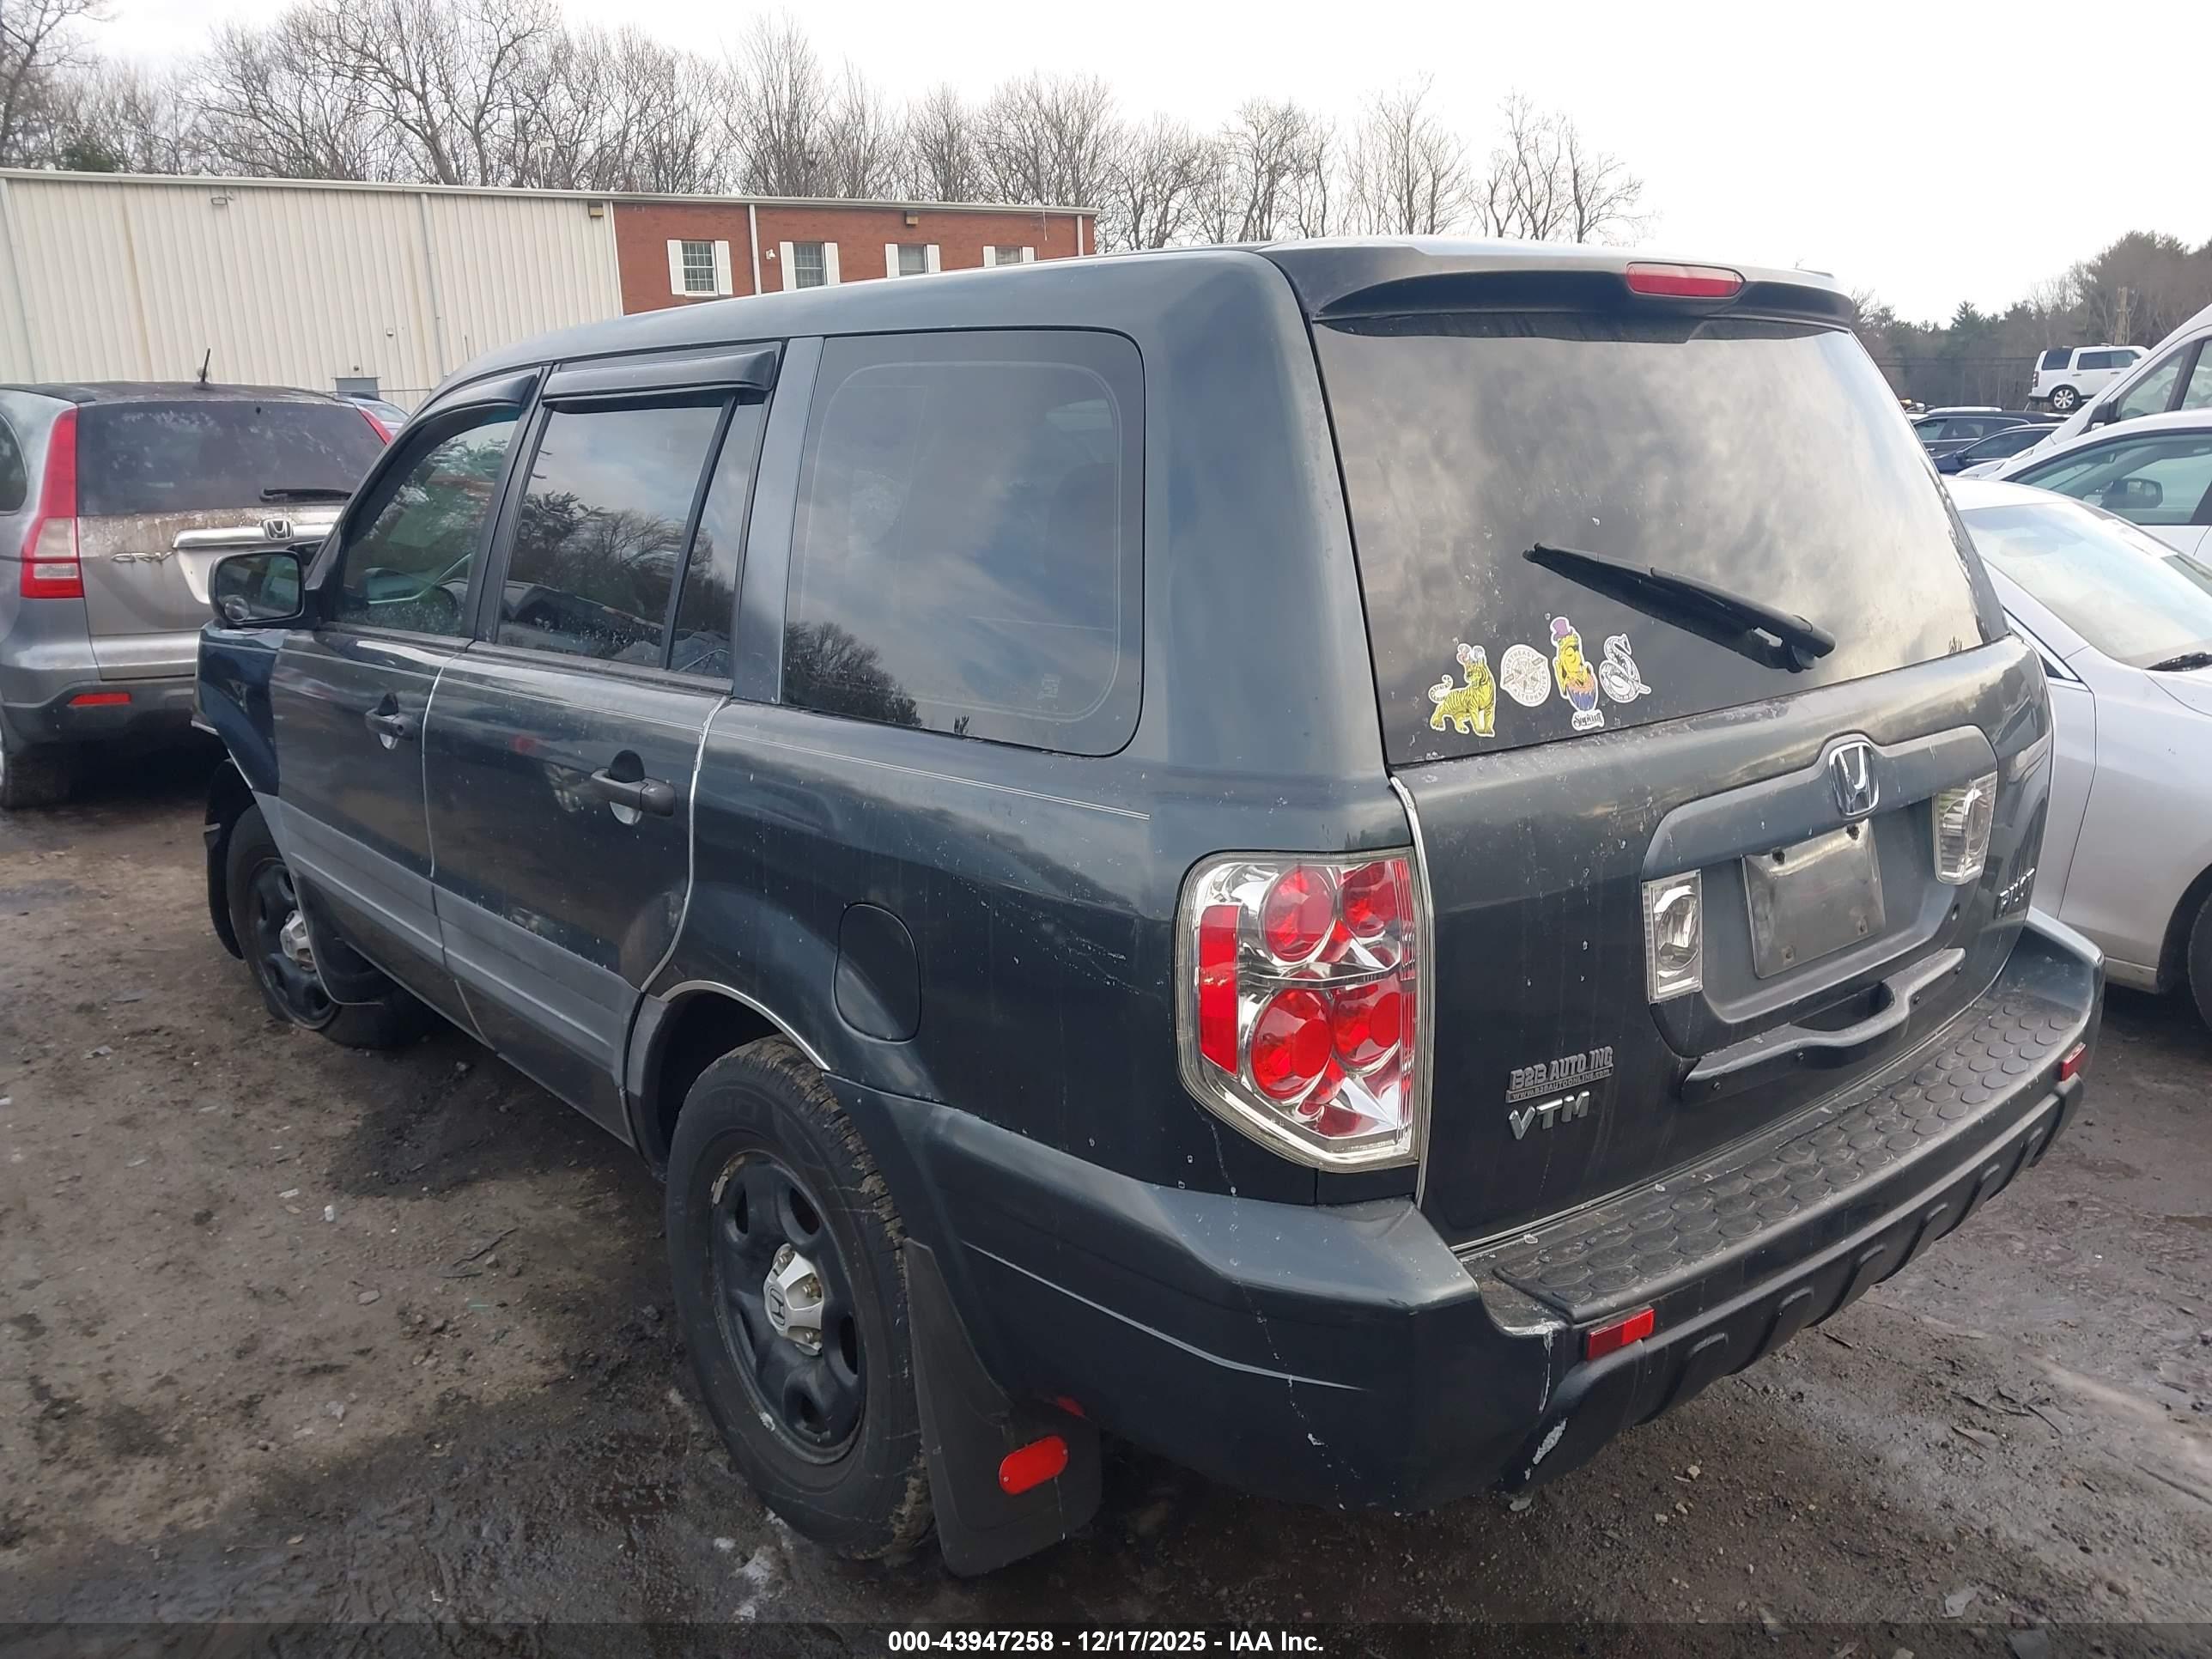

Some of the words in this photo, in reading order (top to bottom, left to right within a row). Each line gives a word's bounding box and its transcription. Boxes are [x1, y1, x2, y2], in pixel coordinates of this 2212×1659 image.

[1510, 1062, 1547, 1091] B2B
[1547, 1053, 1587, 1081] AUTO
[1508, 1090, 1590, 1140] VTM
